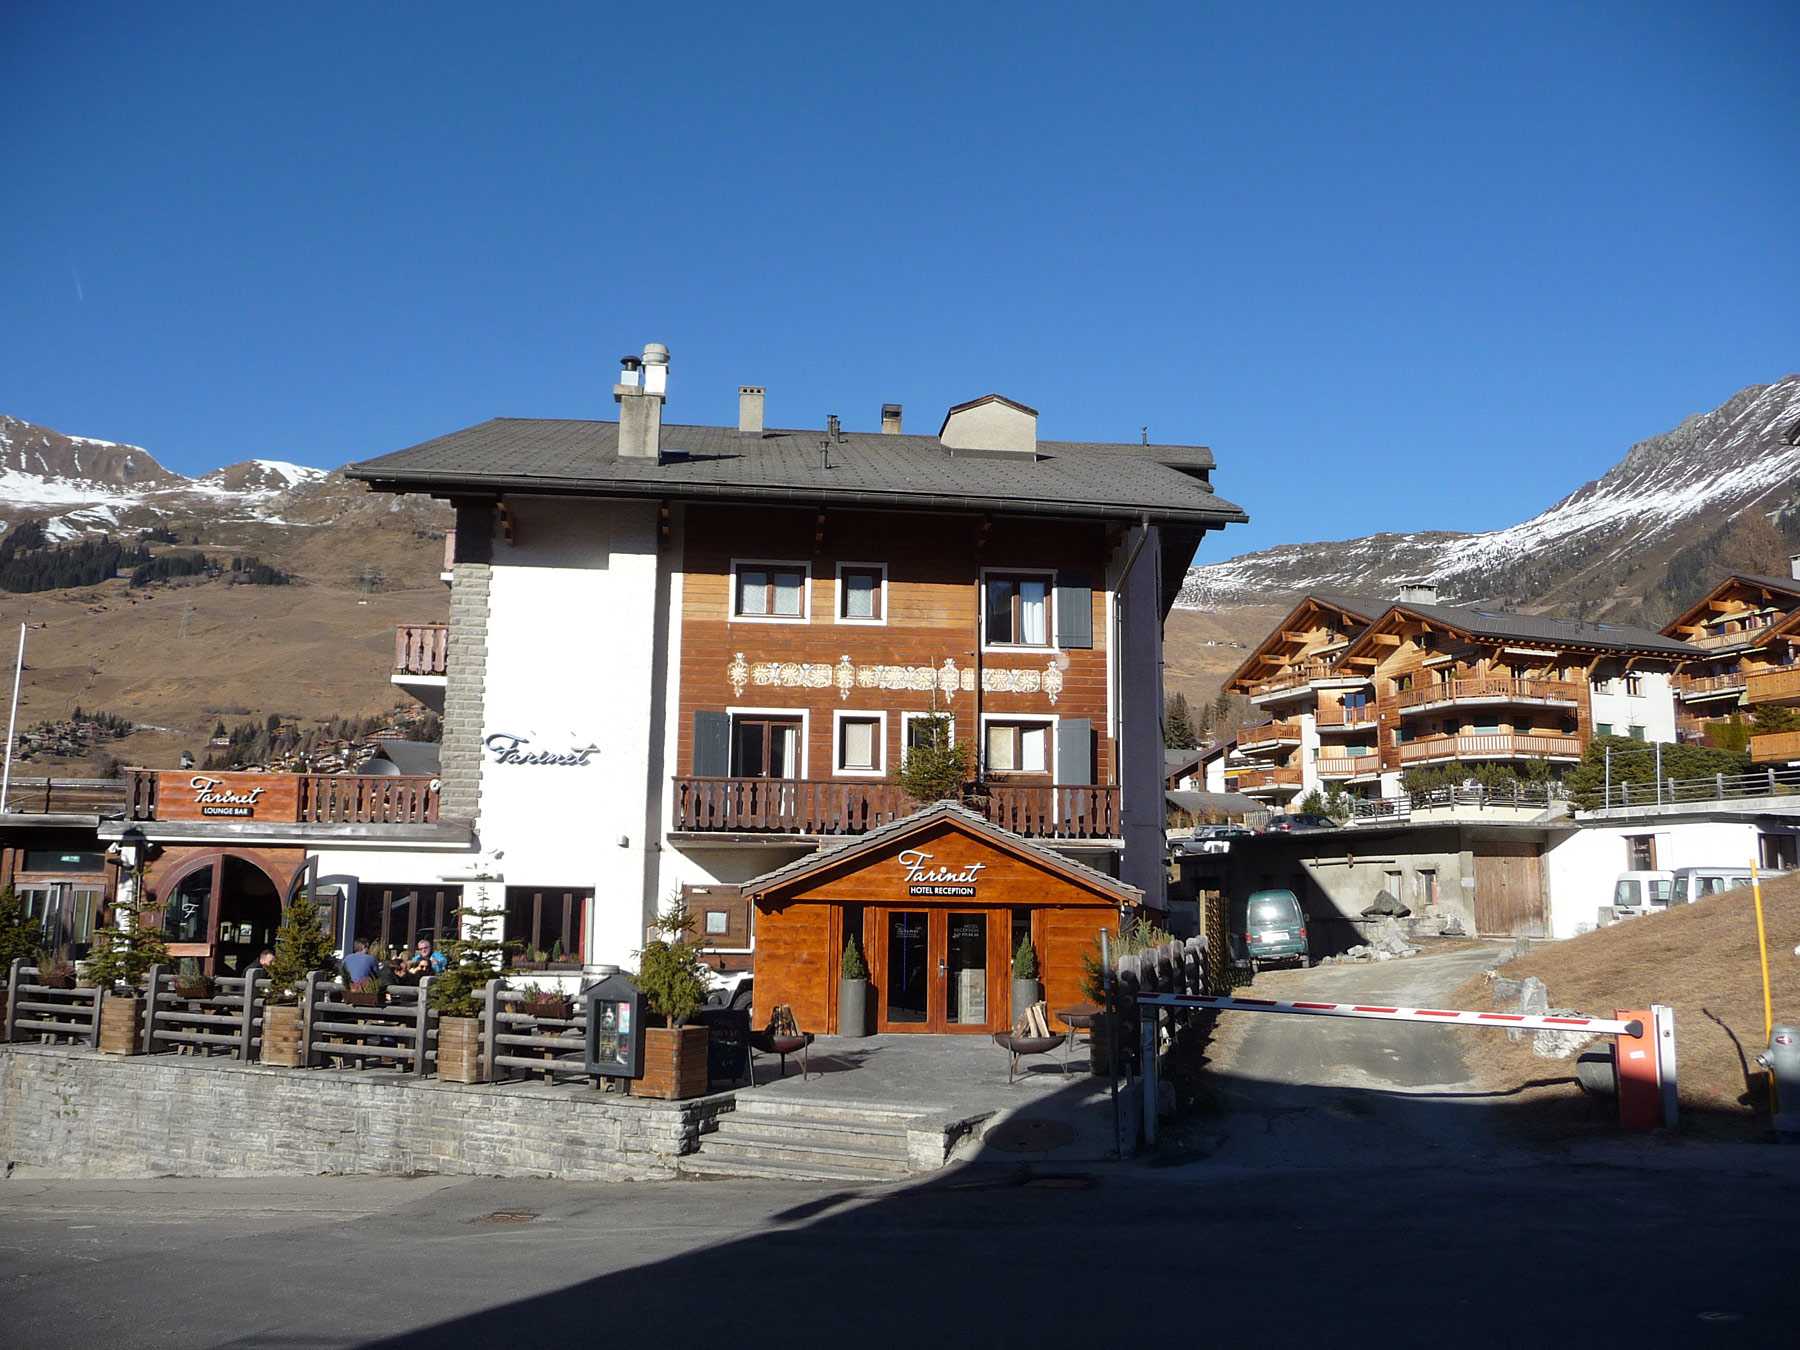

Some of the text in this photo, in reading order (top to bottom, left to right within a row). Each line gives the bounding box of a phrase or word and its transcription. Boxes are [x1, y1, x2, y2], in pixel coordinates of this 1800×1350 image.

[484, 733, 601, 766] Farinet
[190, 775, 266, 804] Farinet
[204, 807, 233, 815] LOUNGE
[898, 849, 986, 882] Farinet
[910, 886, 974, 895] HOTEL RECEPTION
